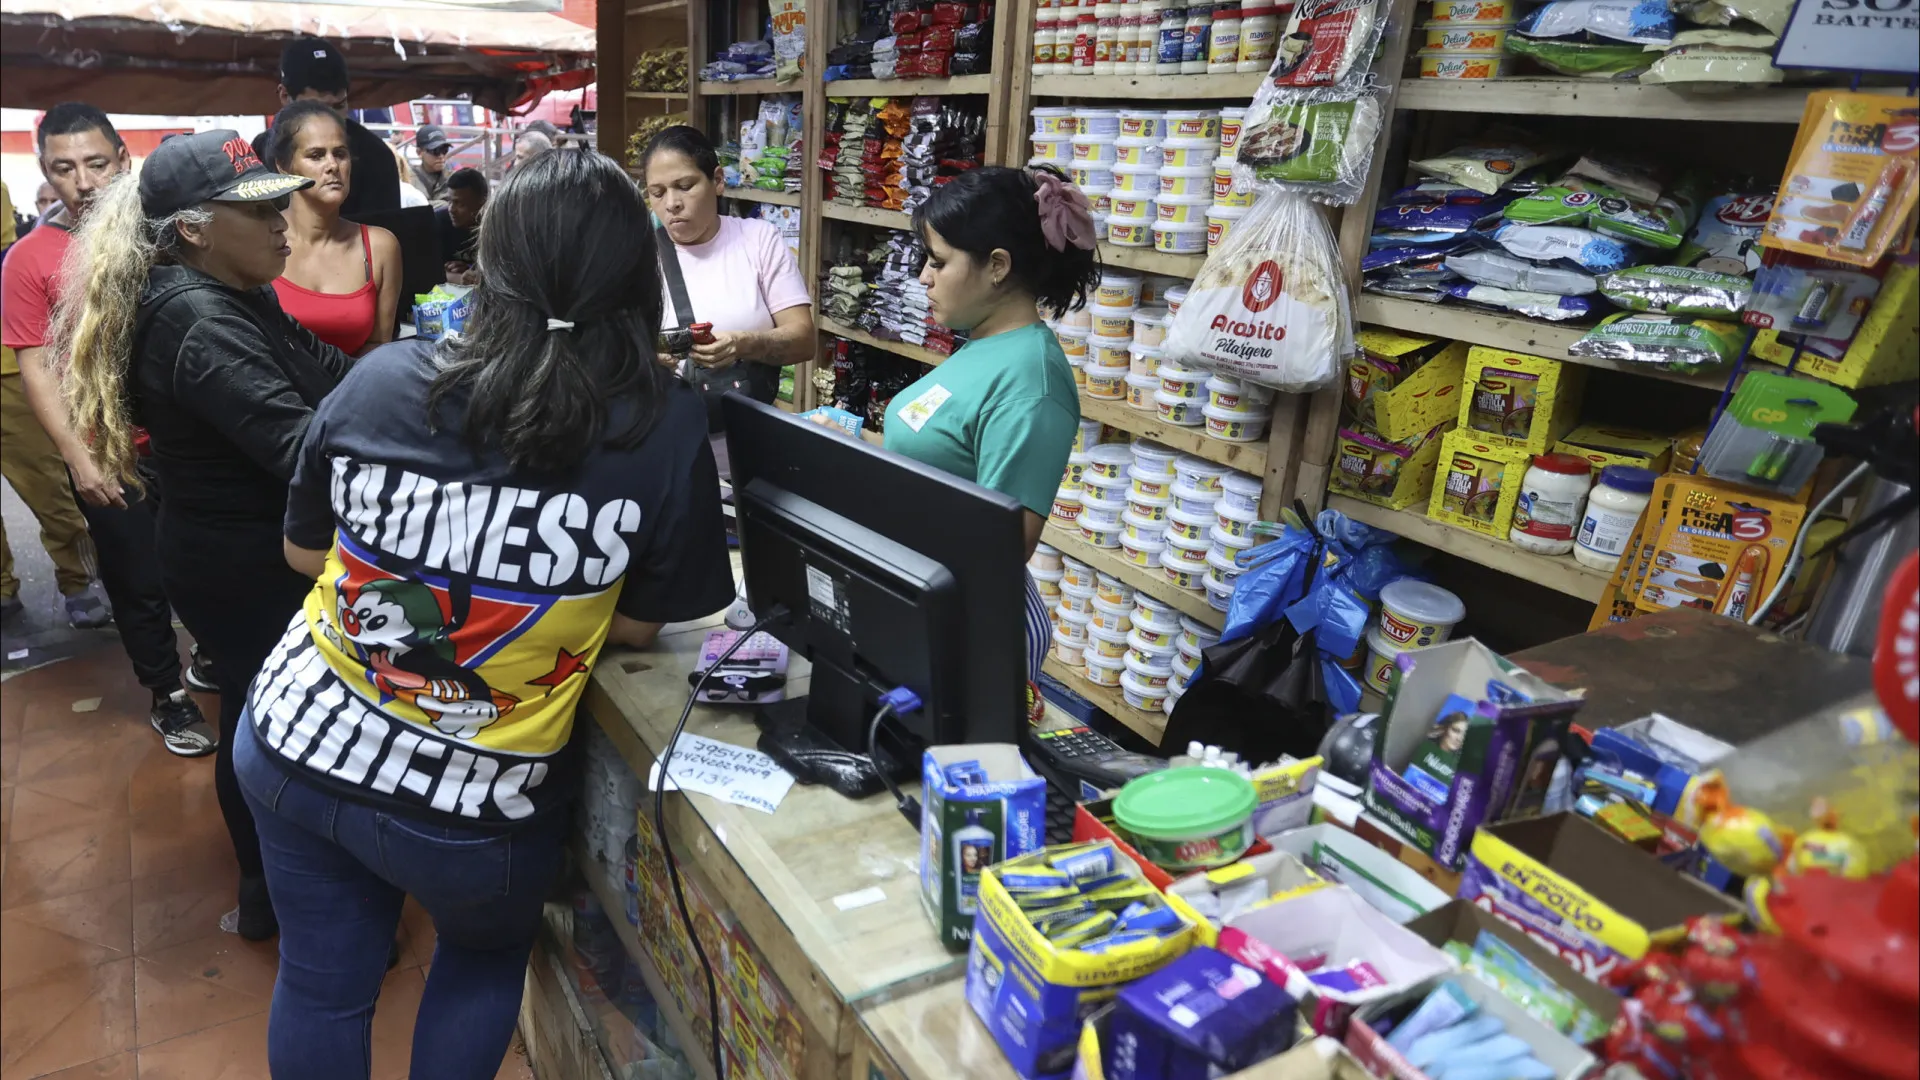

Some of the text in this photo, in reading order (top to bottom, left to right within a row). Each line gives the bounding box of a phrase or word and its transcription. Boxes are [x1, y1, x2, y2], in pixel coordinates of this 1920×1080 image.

[1734, 518, 1765, 538] 3
[1501, 860, 1605, 933] EN POLVO
